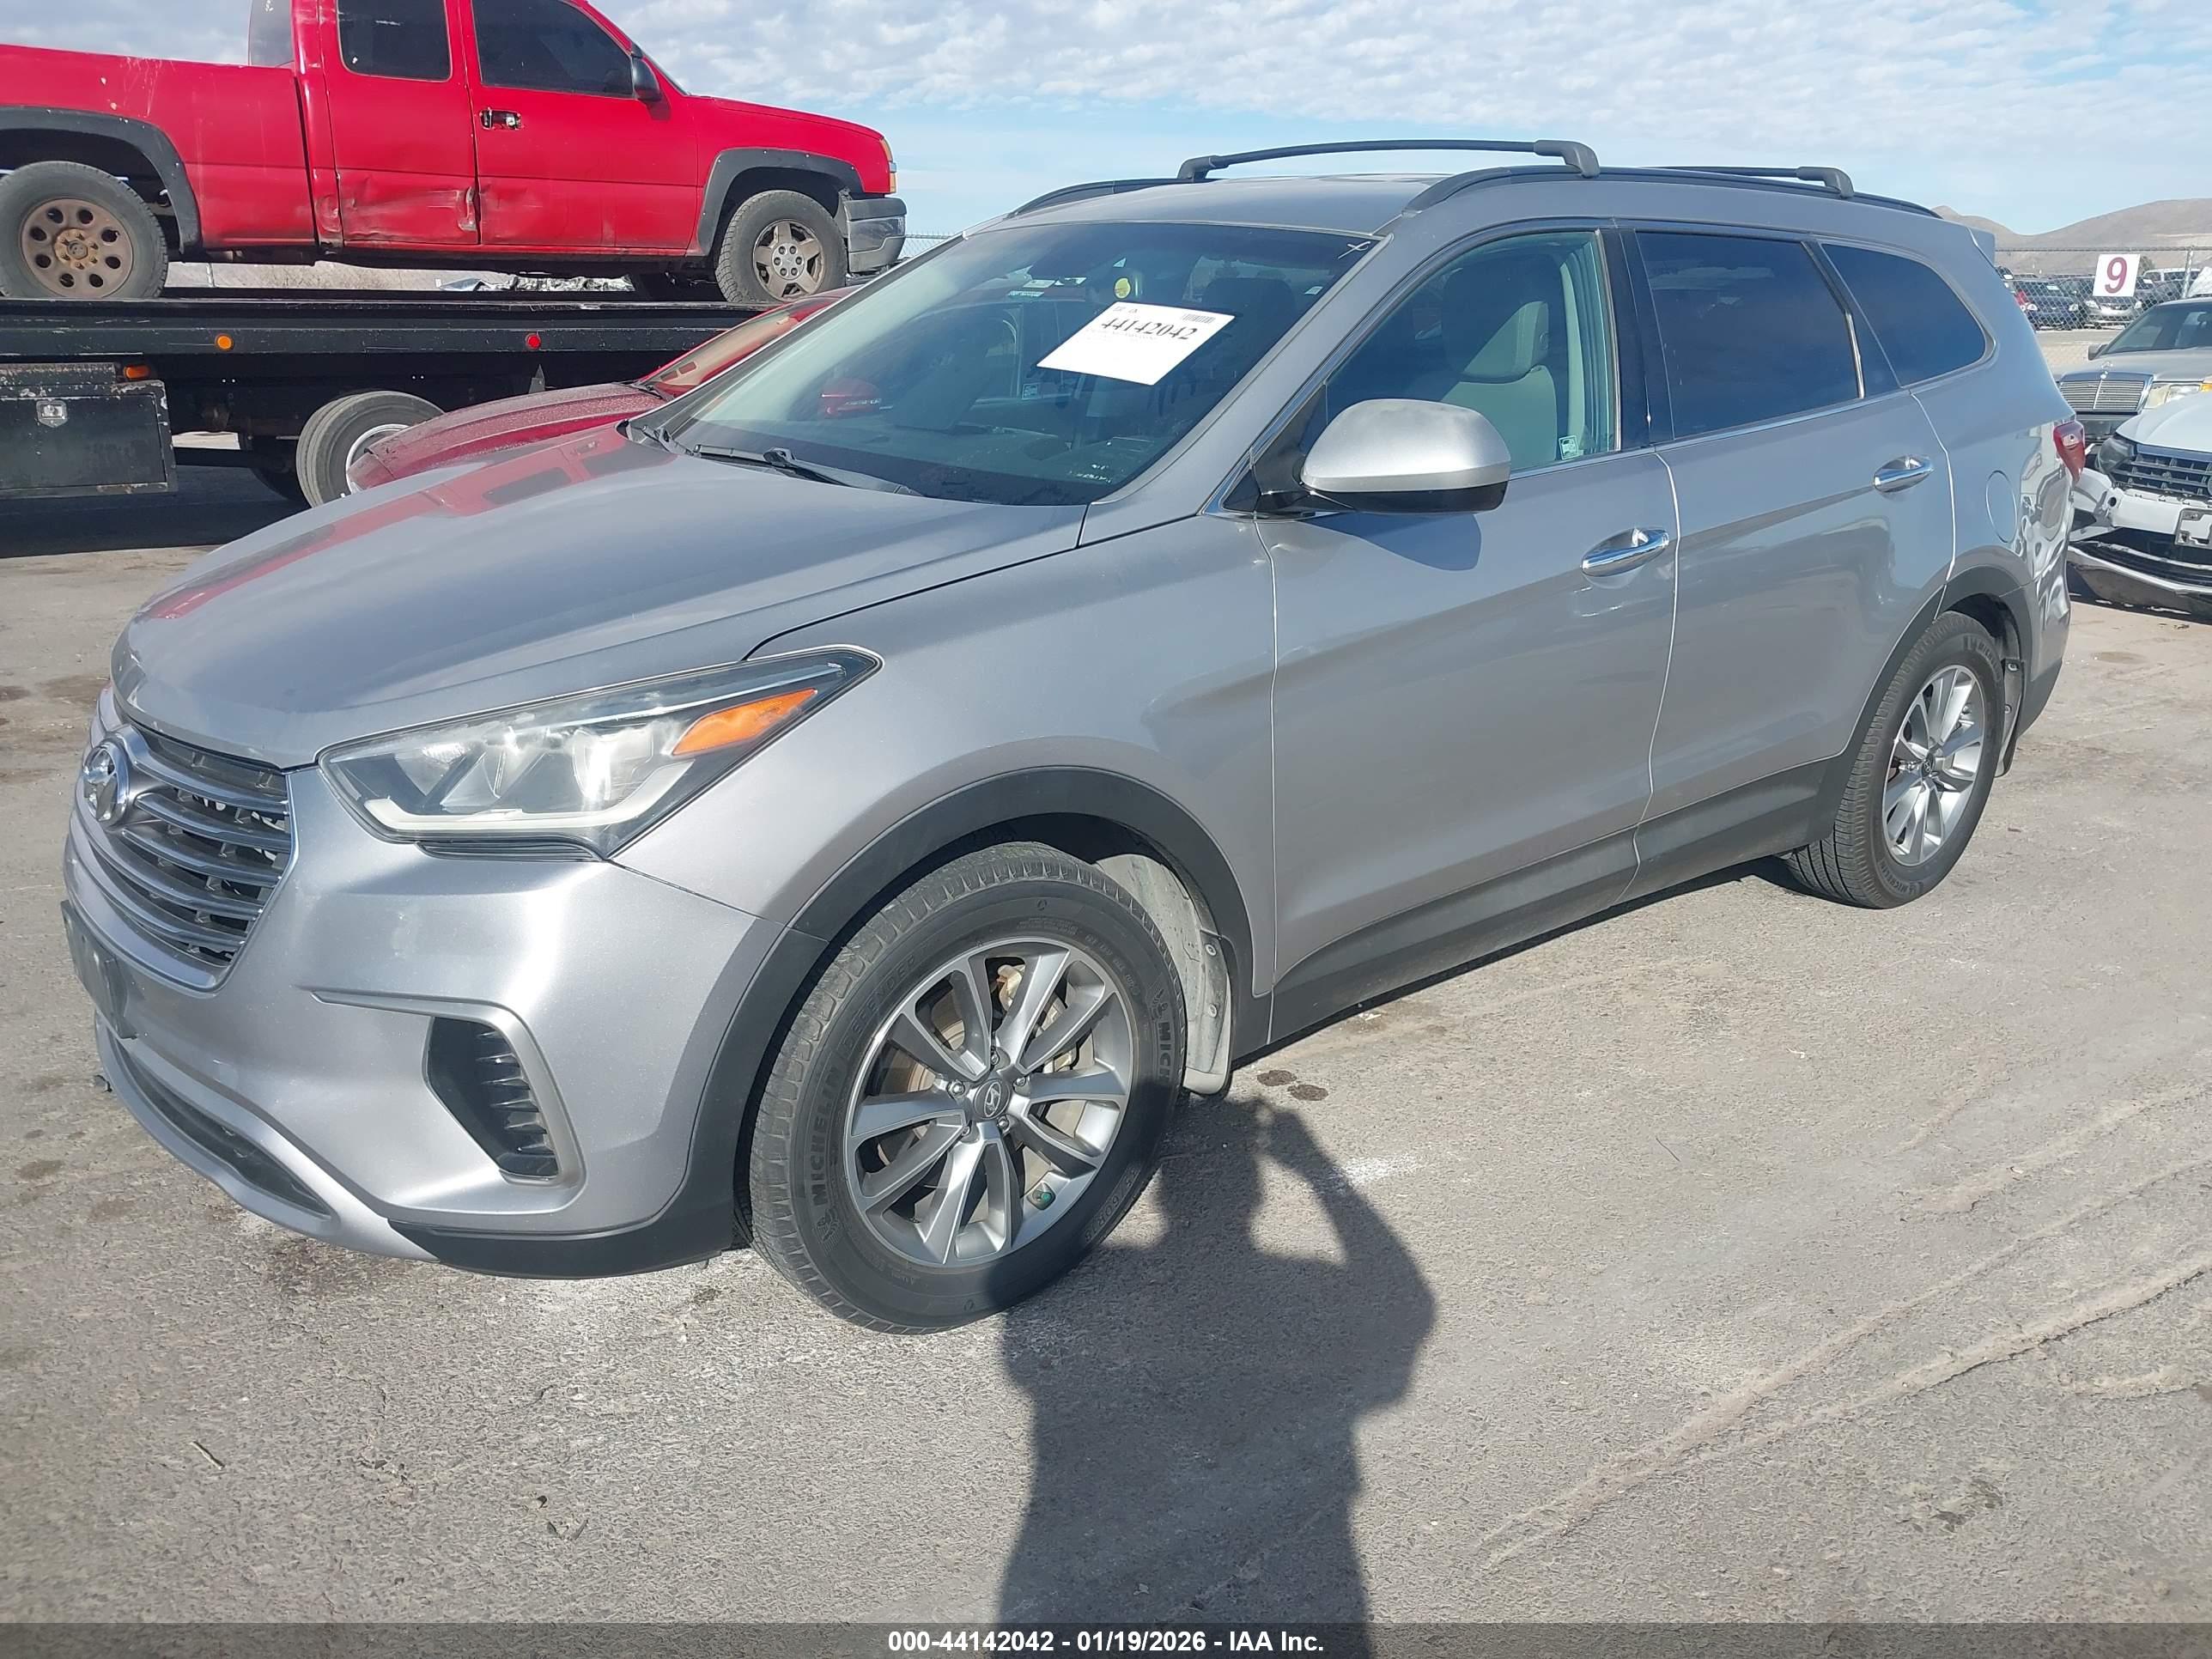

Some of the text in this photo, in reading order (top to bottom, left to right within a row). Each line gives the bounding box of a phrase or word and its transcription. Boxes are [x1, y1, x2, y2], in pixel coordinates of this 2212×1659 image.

[2105, 257, 2128, 294] 9
[1101, 318, 1198, 340] 44142042
[811, 1066, 841, 1206] MICHELIN
